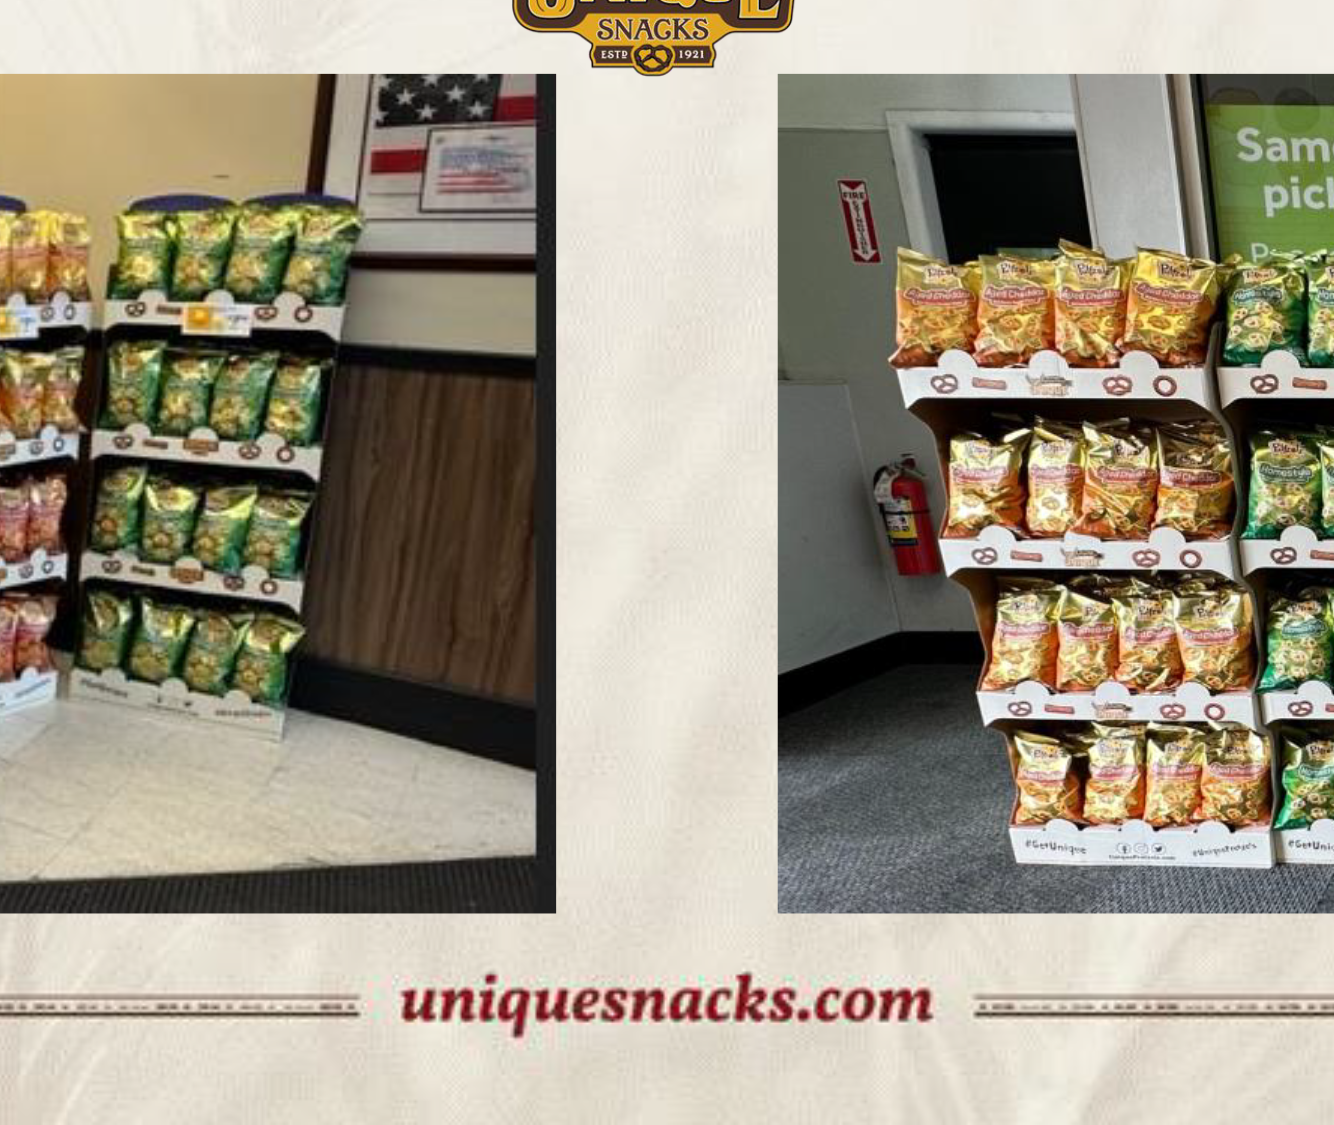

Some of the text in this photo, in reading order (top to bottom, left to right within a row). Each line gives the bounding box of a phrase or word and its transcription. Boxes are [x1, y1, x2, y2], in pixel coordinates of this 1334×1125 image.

[842, 191, 865, 199] FIRE
[1259, 466, 1312, 479] Homestyle
[1025, 841, 1087, 856] #GetUnique
